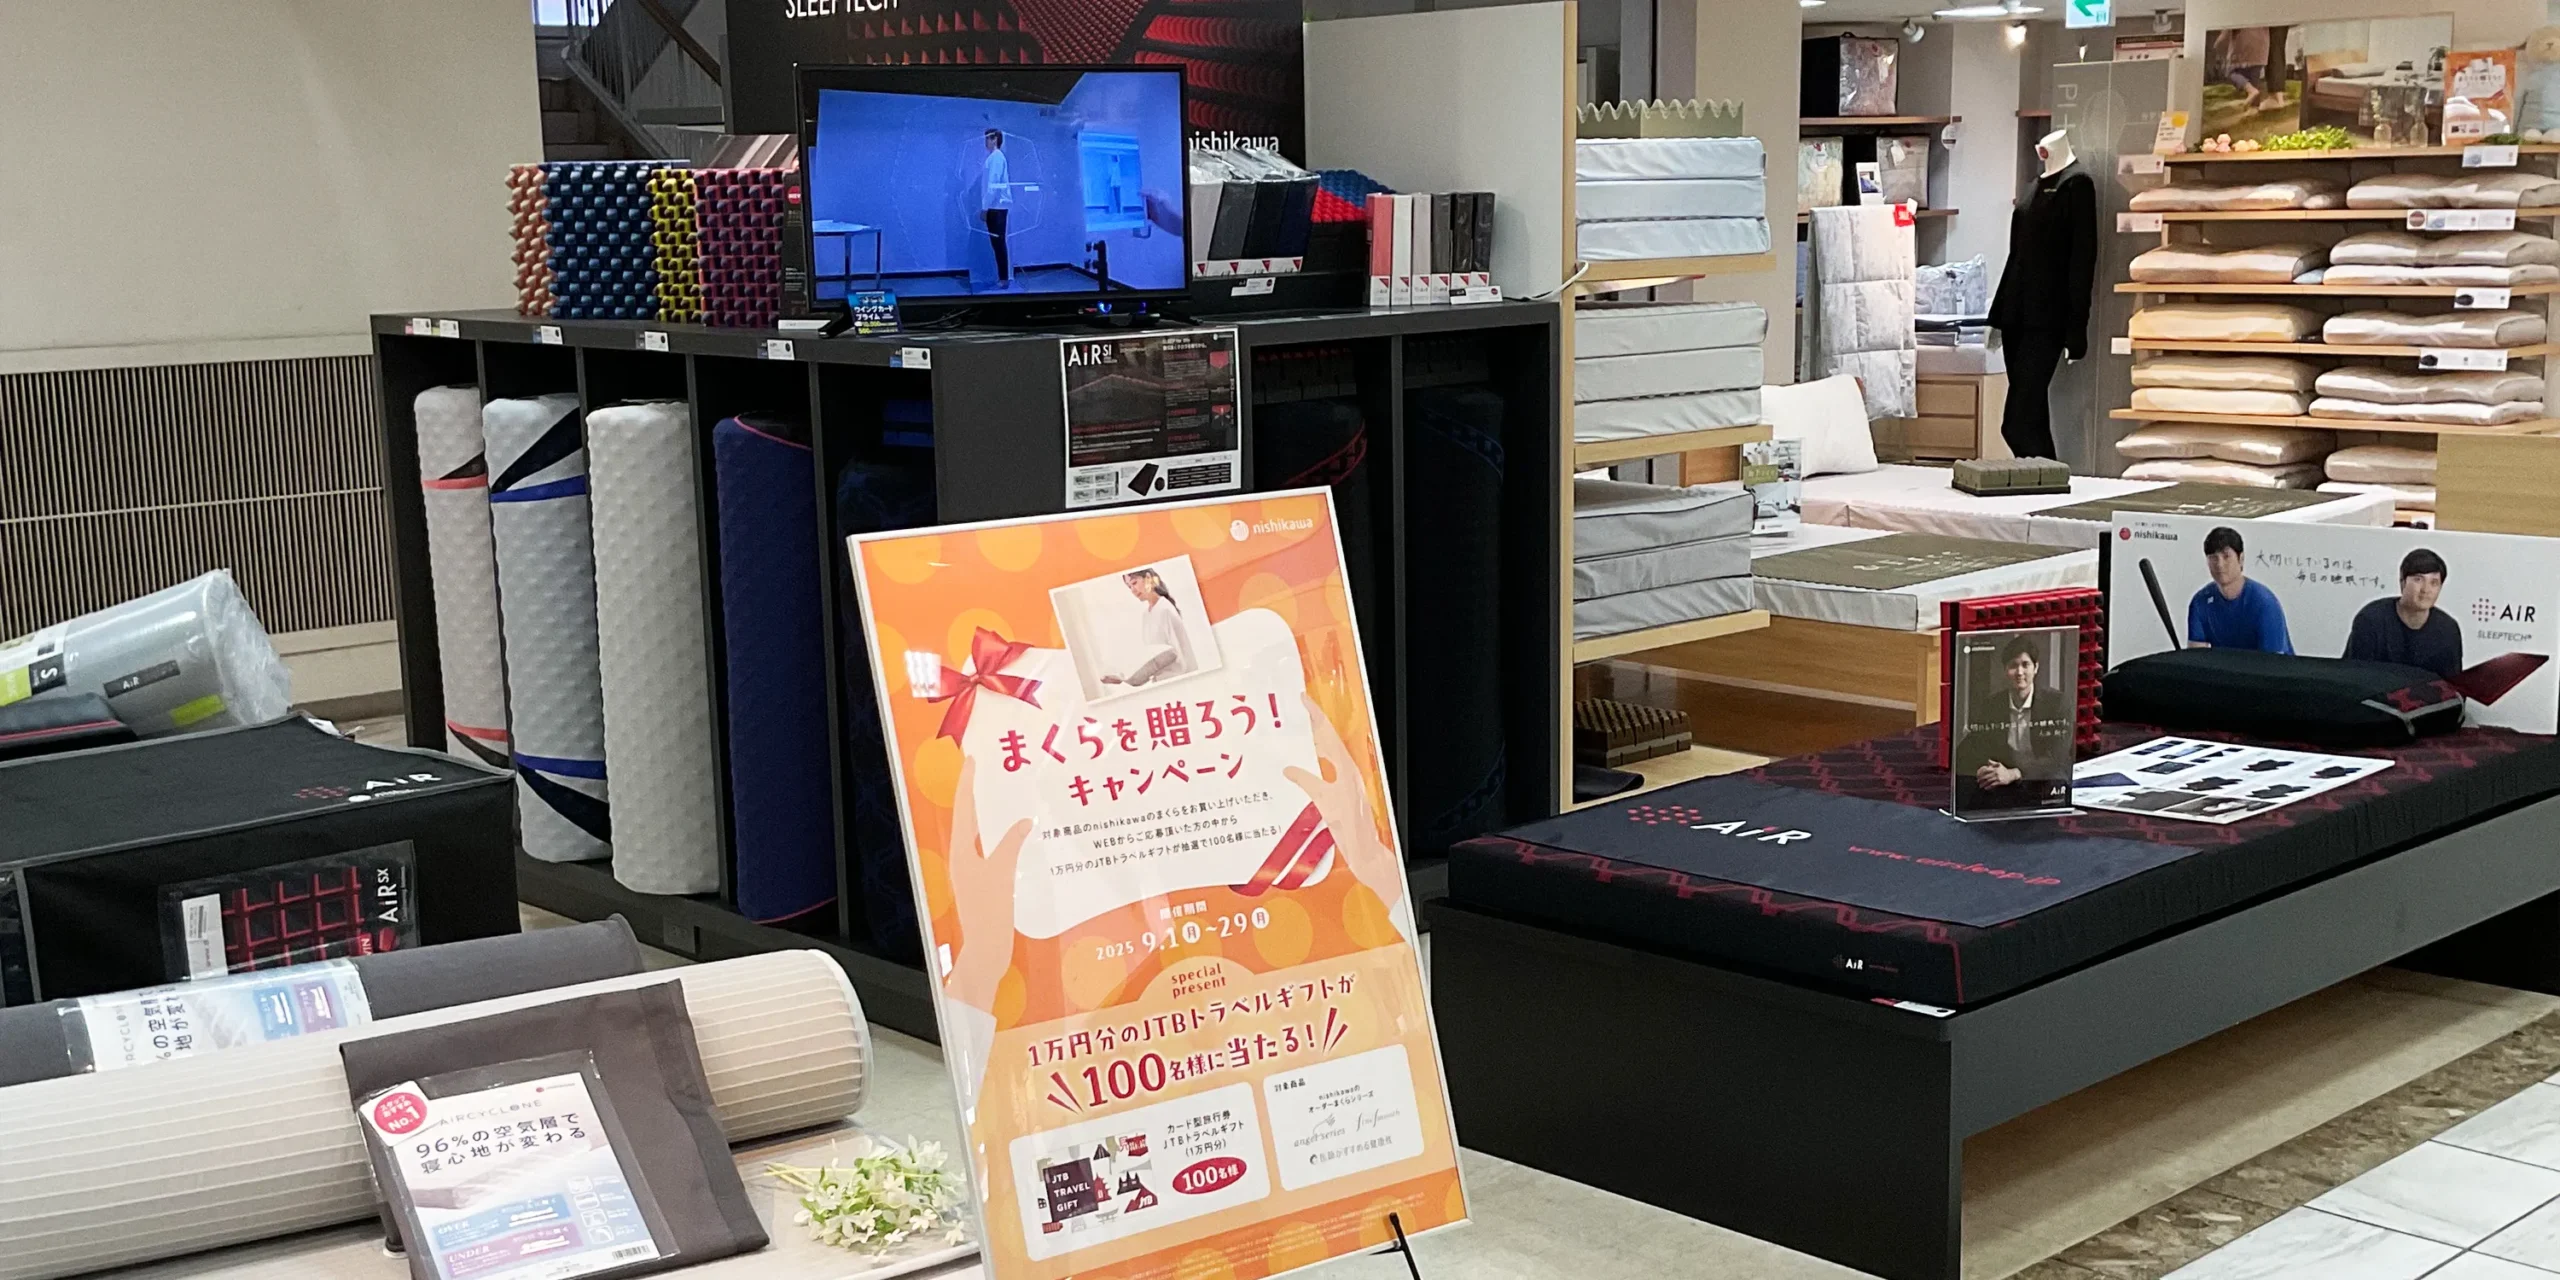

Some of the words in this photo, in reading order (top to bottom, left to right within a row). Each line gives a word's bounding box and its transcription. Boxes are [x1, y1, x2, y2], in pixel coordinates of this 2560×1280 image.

[1253, 517, 1314, 534] nishikawa
[2134, 530, 2178, 541] nishikawa
[998, 692, 1283, 773] まくらを贈ろう!
[1068, 753, 1244, 807] キャンペーン
[1092, 814, 1239, 850] WEBからご応募頂いた方の中から
[1096, 940, 1135, 961] 2025
[1171, 962, 1222, 986] special
[1172, 976, 1227, 1000] present
[1027, 972, 1357, 1067] 1万円分のJTBトラベルギフトが
[388, 1105, 421, 1132] No.1
[1166, 1109, 1232, 1135] カード型旅行券
[415, 1113, 580, 1159] 96%の空気層で
[1163, 1120, 1246, 1150] JTBトラベルギフト
[1185, 1138, 1228, 1158] (1万円分)
[421, 1127, 586, 1174] 寝心地が変わる
[1051, 1172, 1070, 1185] JTB
[1053, 1182, 1091, 1199] TRAVEL
[1182, 1164, 1239, 1192] 100名様
[1056, 1199, 1080, 1213] GIFT
